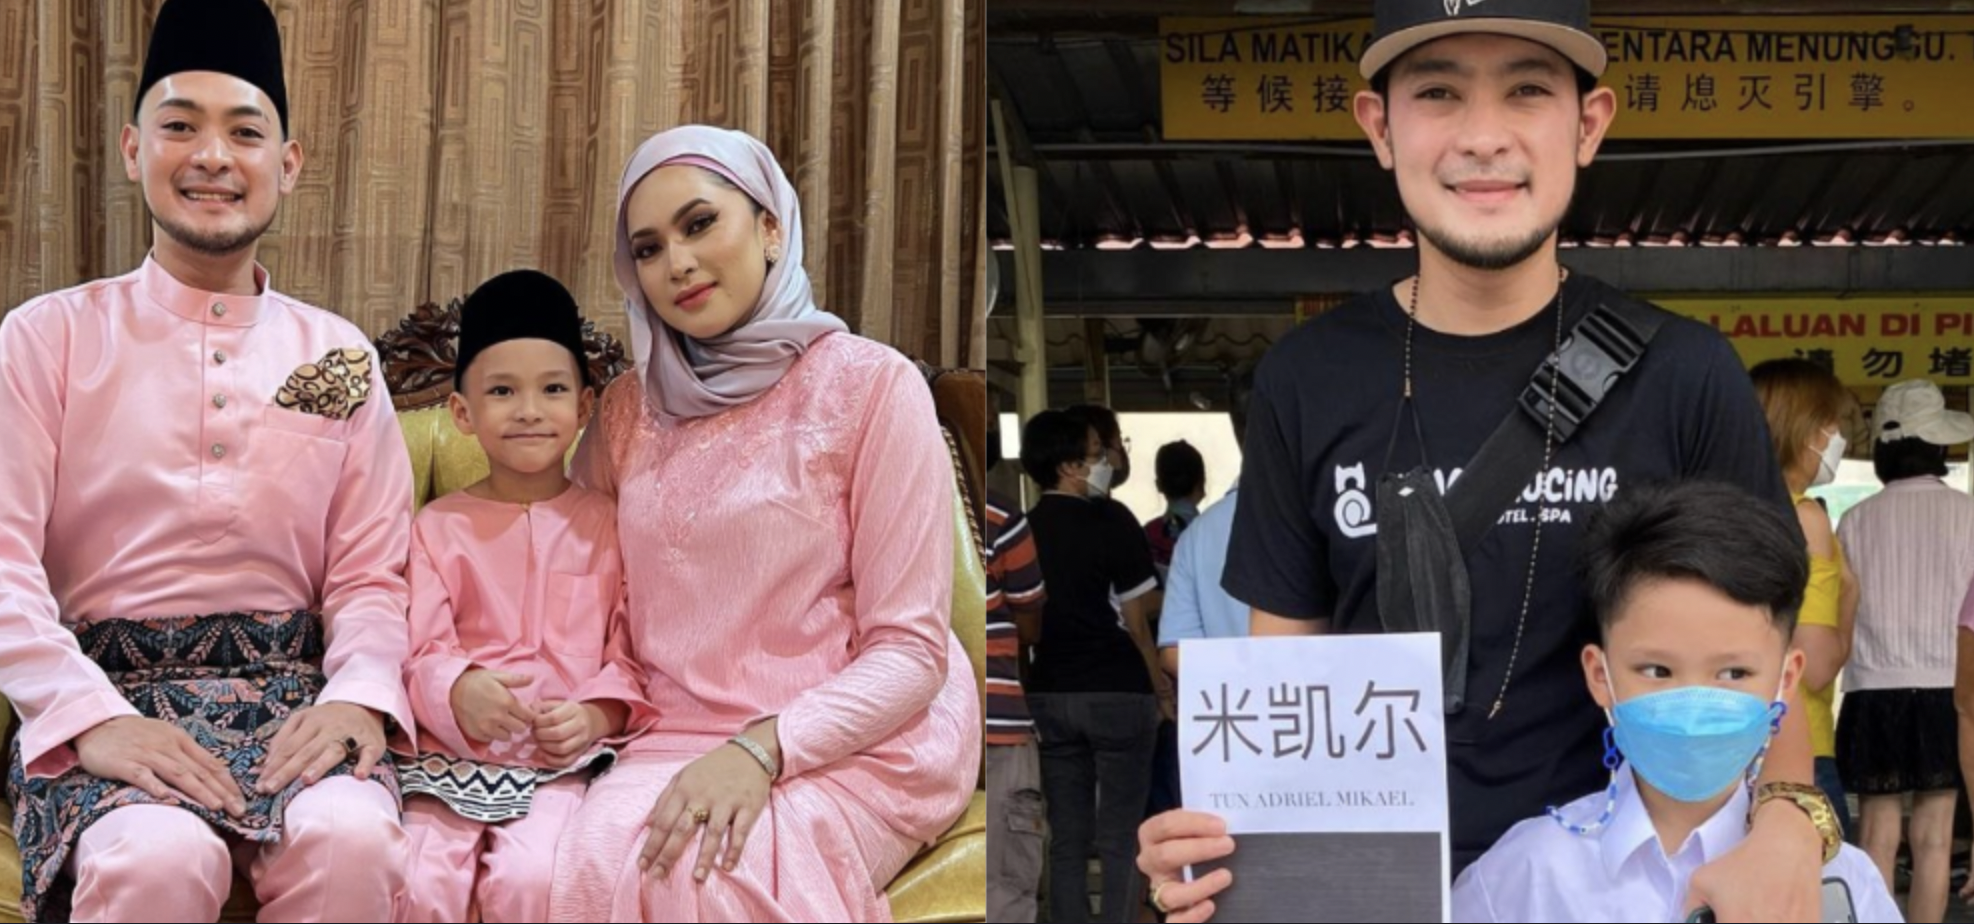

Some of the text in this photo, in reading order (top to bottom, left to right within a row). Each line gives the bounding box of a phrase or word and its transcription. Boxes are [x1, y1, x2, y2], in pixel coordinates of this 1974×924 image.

[1165, 32, 1242, 63] SILA
[1602, 31, 1737, 62] ENTARA
[1880, 313, 1920, 337] DI
[1192, 680, 1427, 763] 米凯尔
[1209, 789, 1415, 809] TUN ADRIEL MIKAEL
